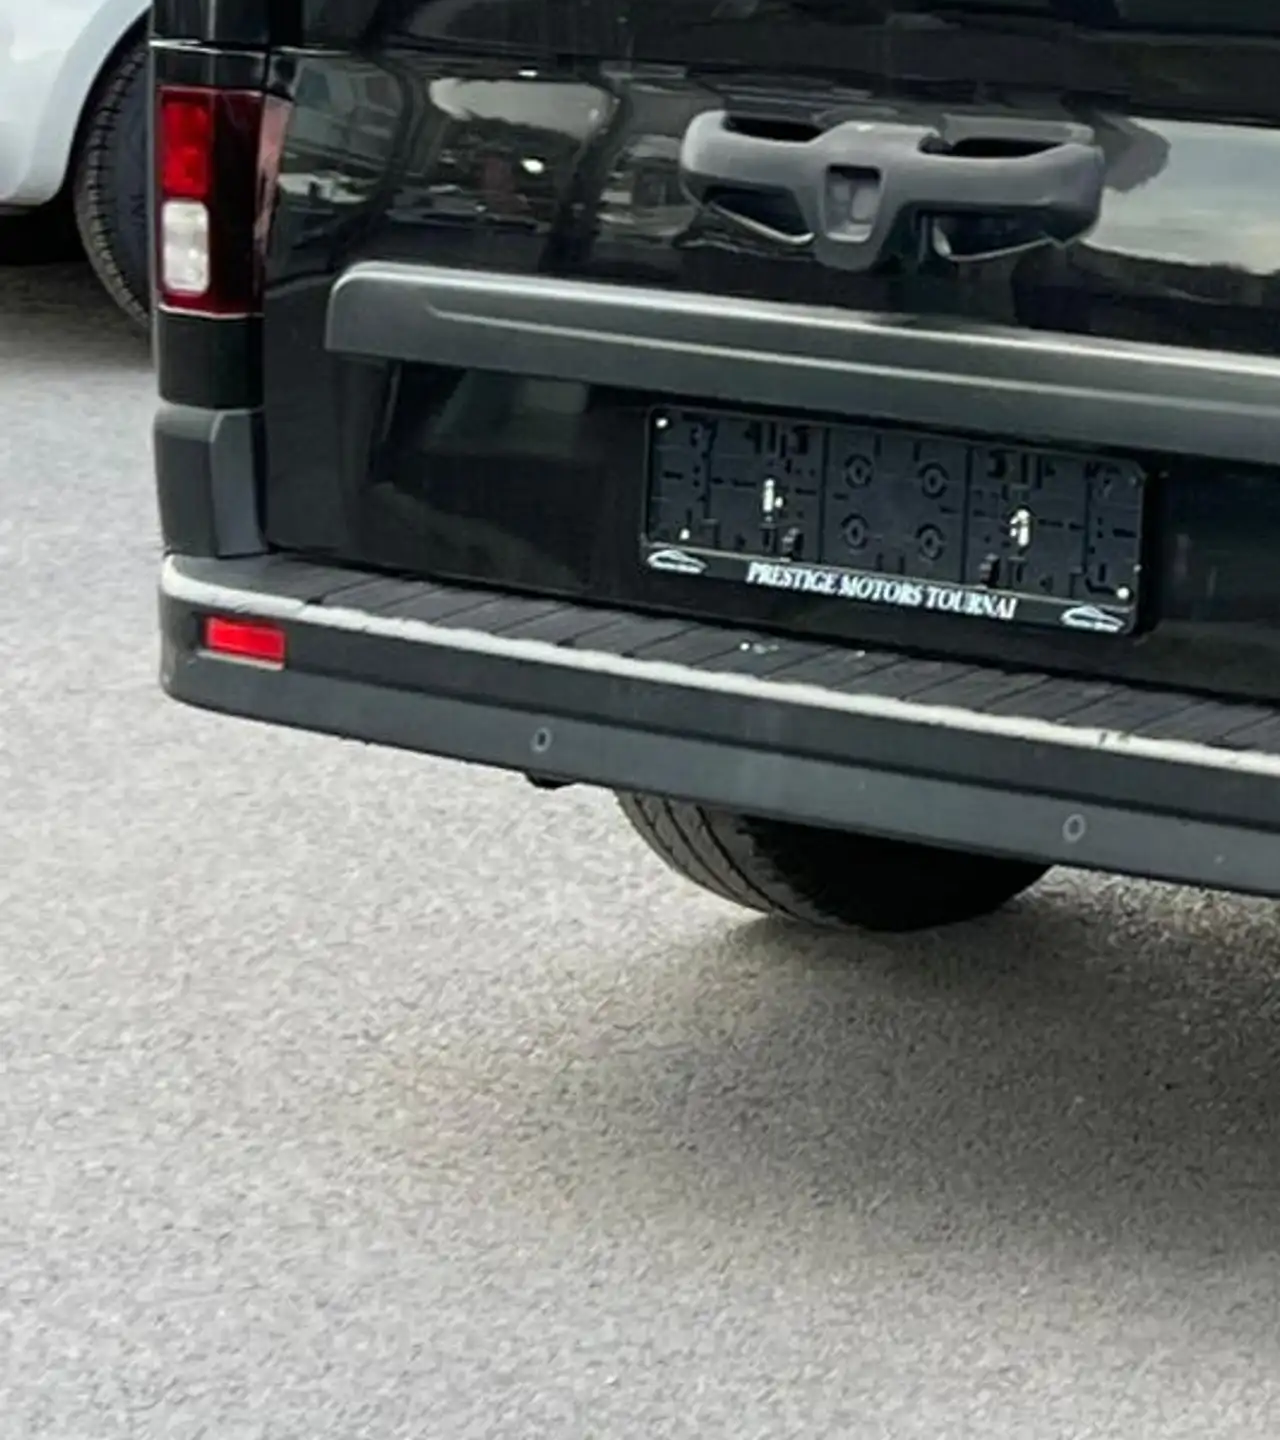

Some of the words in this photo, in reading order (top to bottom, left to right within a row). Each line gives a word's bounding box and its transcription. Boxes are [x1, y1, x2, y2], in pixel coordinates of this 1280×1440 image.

[745, 560, 840, 596] PRESTIGE
[838, 574, 924, 605] MOTORS
[924, 585, 1019, 621] TOURNAI
